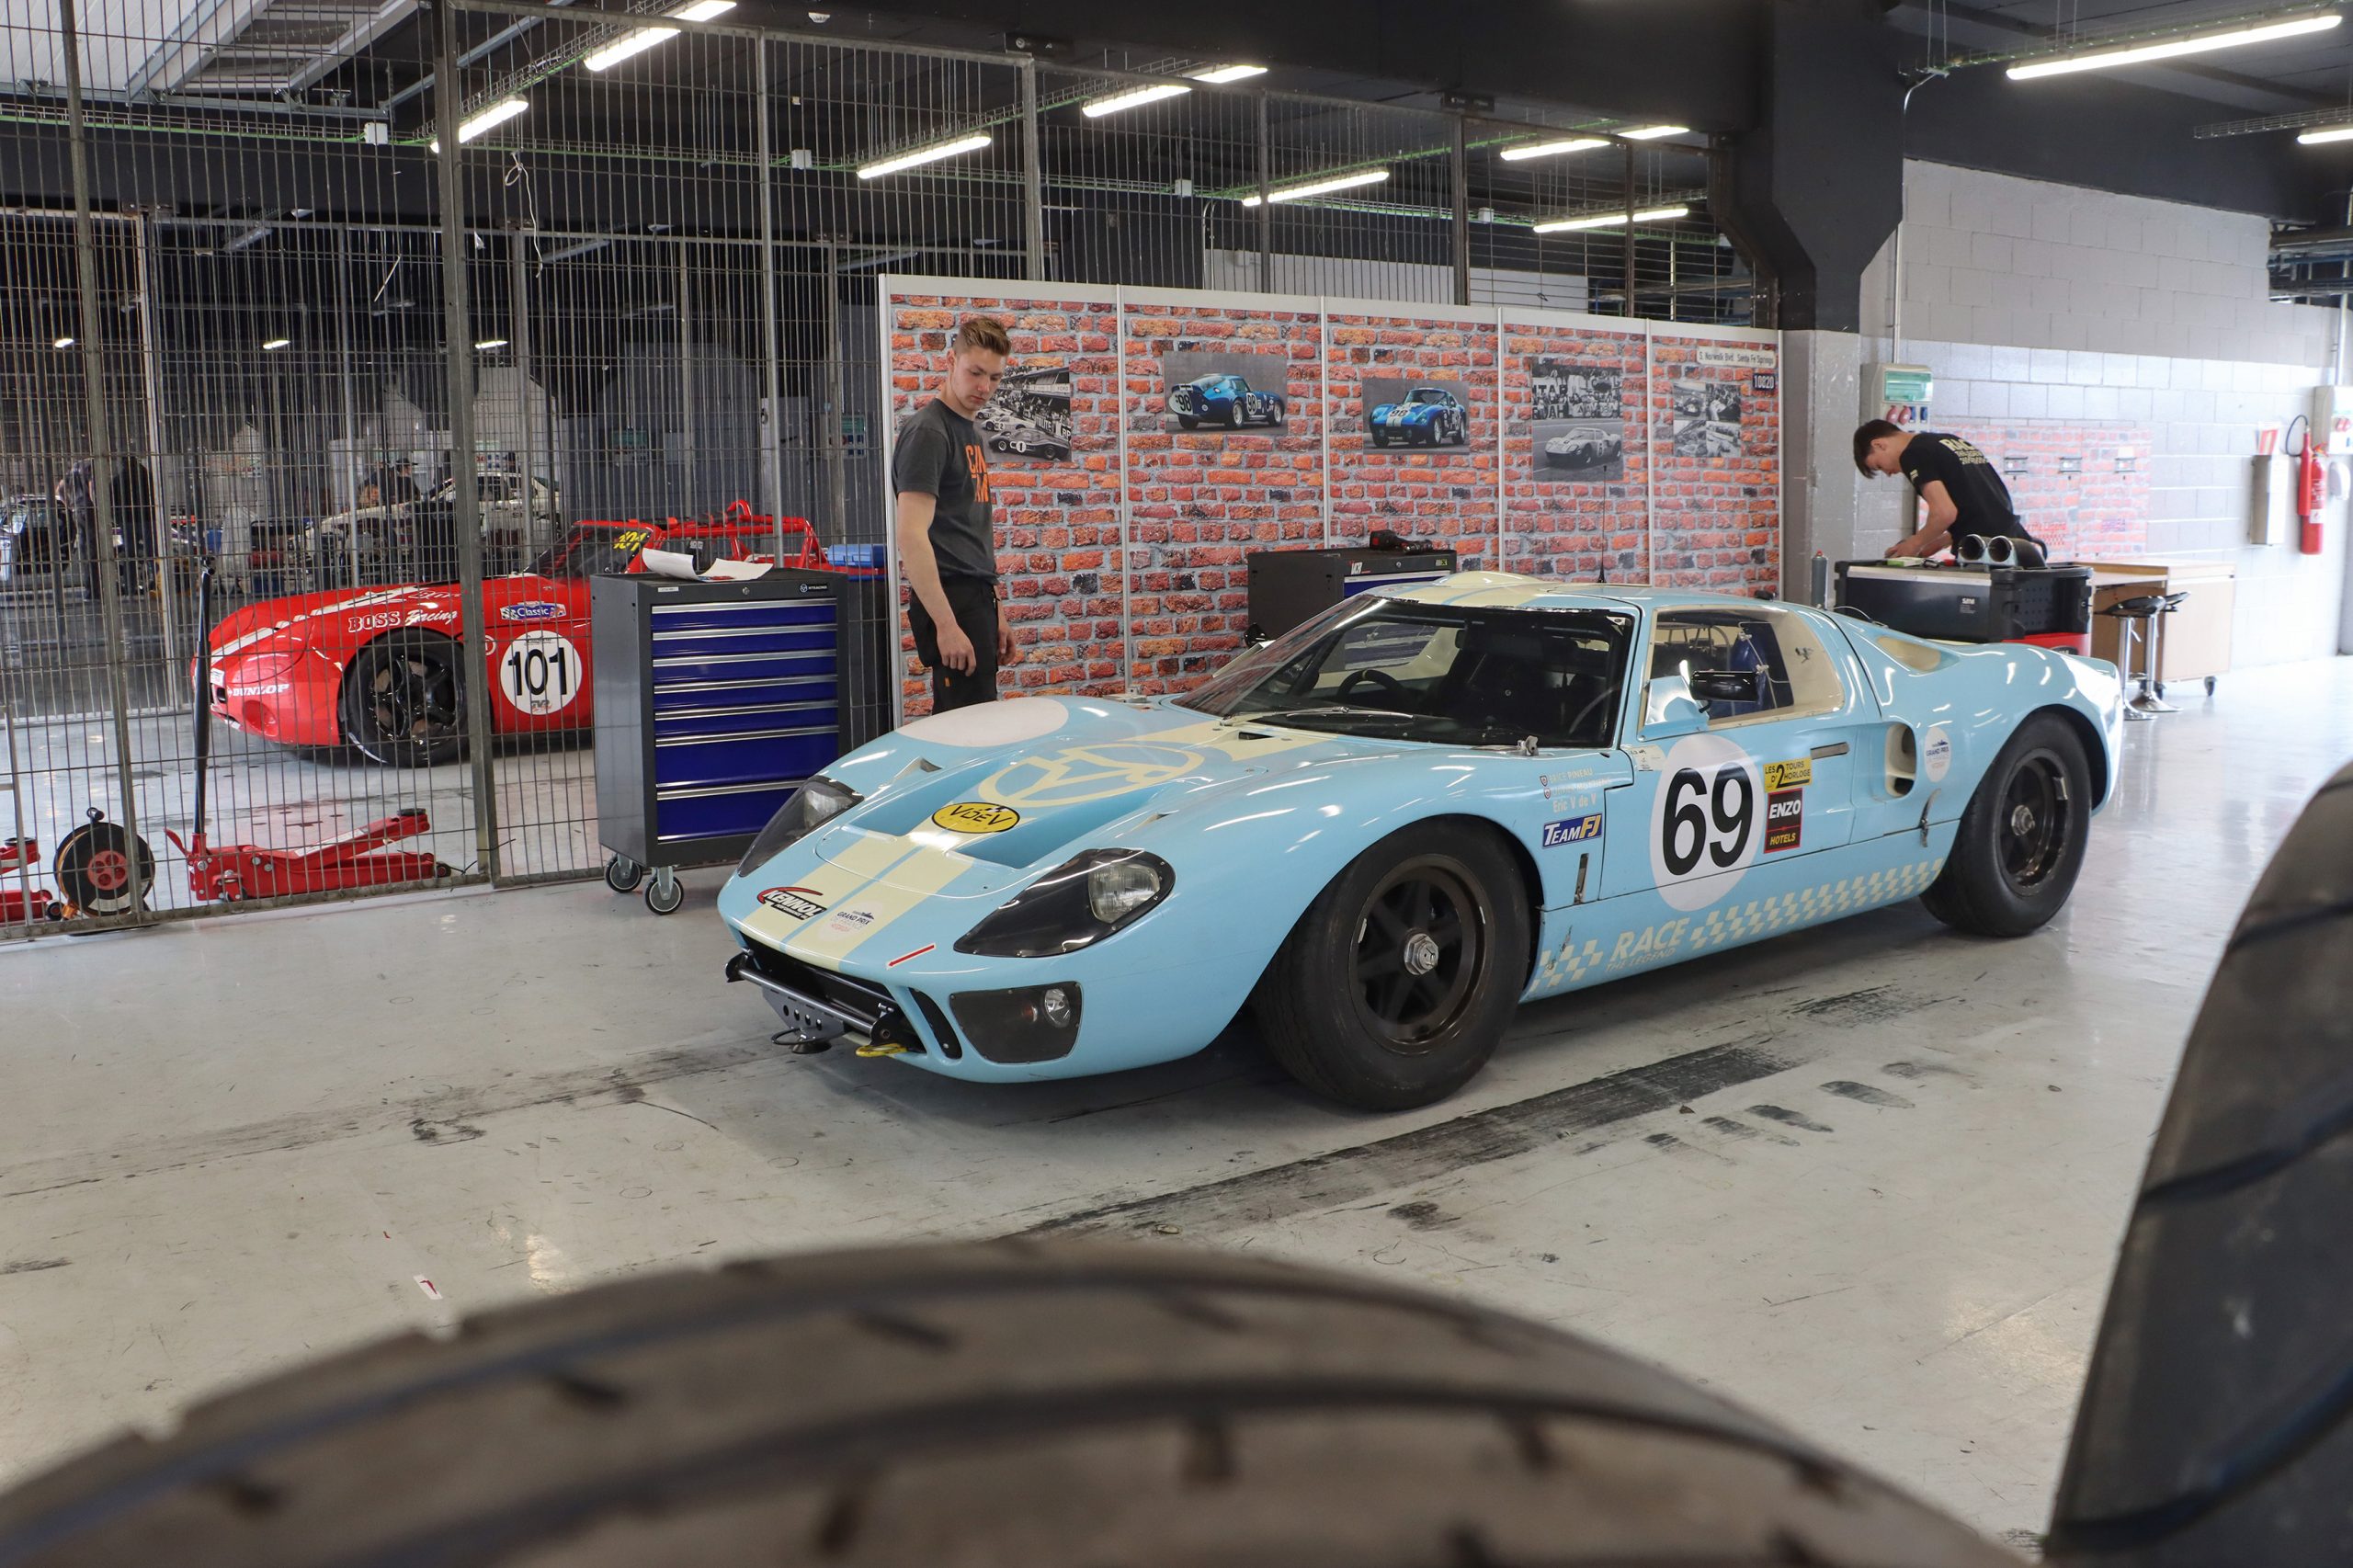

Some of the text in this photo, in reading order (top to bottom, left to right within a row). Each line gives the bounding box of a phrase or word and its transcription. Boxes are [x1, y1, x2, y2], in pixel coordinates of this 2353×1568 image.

[1177, 393, 1192, 412] 98
[1246, 393, 1256, 413] 98
[1389, 409, 1408, 417] 98
[348, 608, 458, 632] BOSS Racing
[517, 607, 550, 617] Classic
[507, 646, 567, 696] 101
[233, 683, 290, 697] DUNLOP
[1765, 767, 1776, 775] LES
[1786, 760, 1804, 771] TOURS
[1784, 768, 1811, 780] HORLOGE
[1552, 792, 1597, 813] Eric V de V
[1768, 799, 1802, 820] ENZO
[1662, 761, 1754, 876] 69
[1769, 832, 1796, 846] HOTELS
[762, 890, 824, 916] KENNOL
[836, 911, 870, 926] GRAND PRIX
[1609, 917, 1690, 962] RACE
